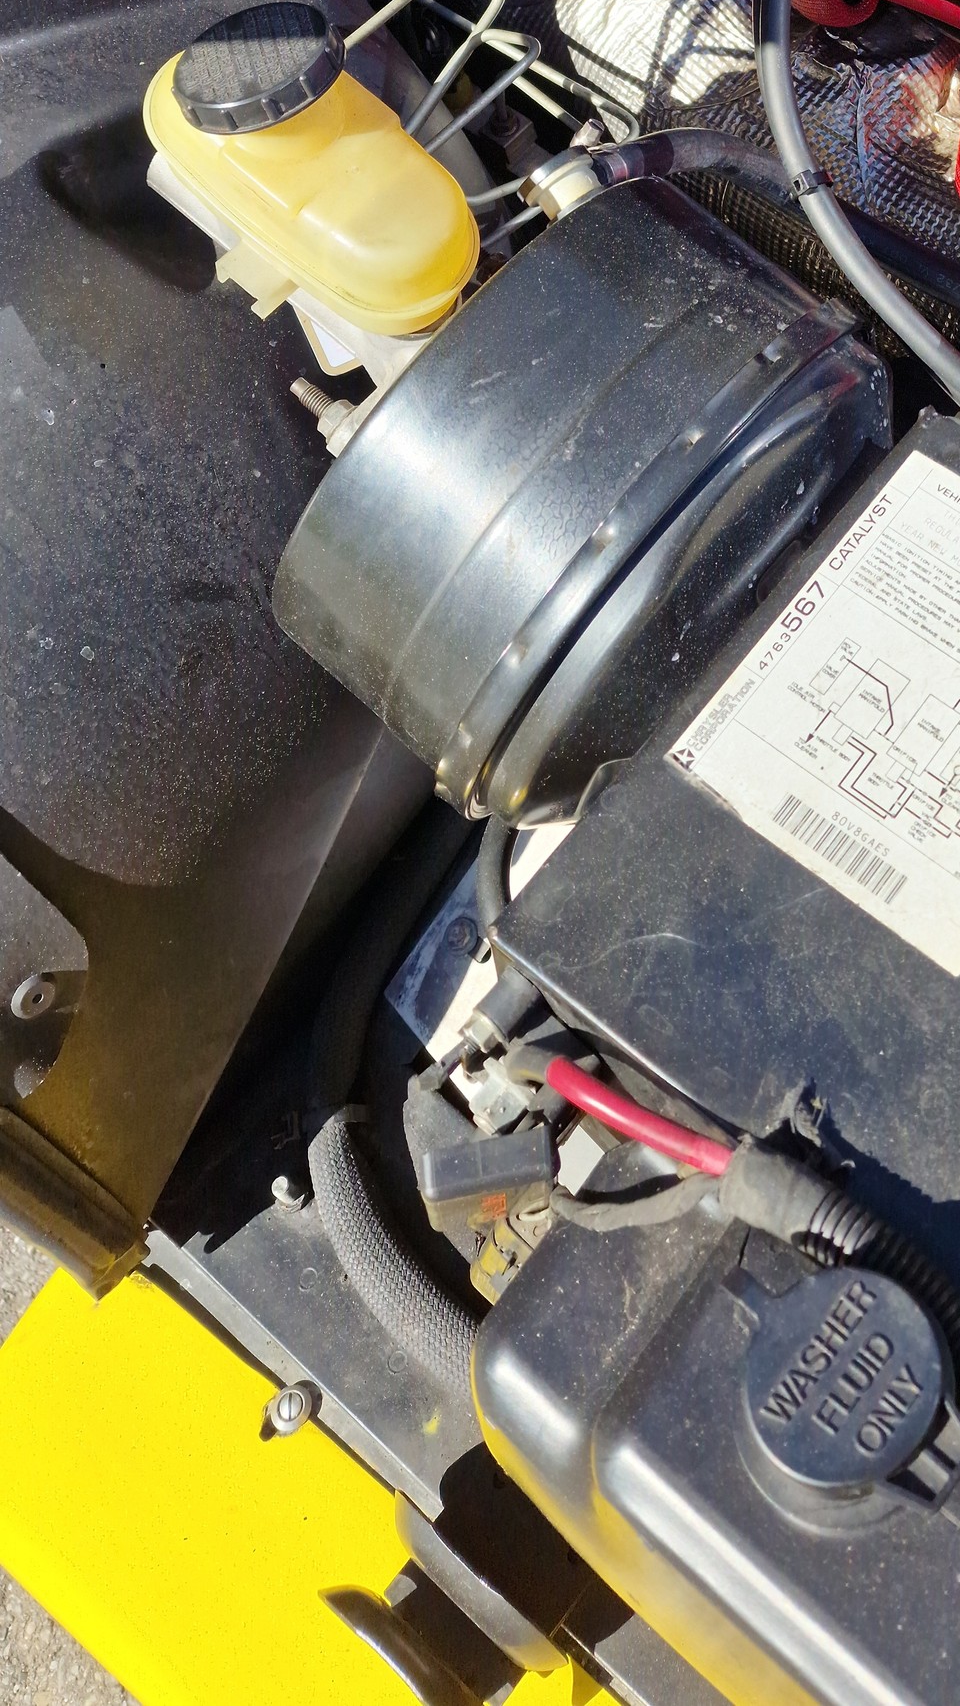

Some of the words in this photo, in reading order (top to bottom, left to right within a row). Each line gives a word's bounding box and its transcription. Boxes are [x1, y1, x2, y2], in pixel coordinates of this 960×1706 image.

[828, 494, 893, 571] CATALYST
[898, 521, 925, 541] YEAR
[926, 539, 948, 556] NEW
[874, 546, 895, 561] MANUAL
[895, 560, 908, 570] FOR
[908, 568, 930, 585] PROPER
[878, 540, 893, 551] HAVE
[894, 550, 910, 562] BEEN
[910, 560, 931, 576] PRESET
[942, 581, 954, 591] THE
[903, 546, 931, 566] IGNITION
[931, 565, 953, 580] TIMING
[854, 571, 878, 589] FEDERAL
[879, 587, 892, 597] AND
[892, 596, 910, 610] STATE
[859, 564, 883, 582] SERVICE
[884, 581, 906, 597] MANUAL
[906, 596, 942, 621] PROCEDURES
[942, 619, 954, 629] MAY
[864, 558, 901, 585] ADJUSTMENTS
[902, 583, 917, 595] MADE
[928, 600, 946, 614] OTHER
[893, 606, 919, 625] PARKING
[919, 623, 938, 638] BRAKE
[938, 636, 955, 649] WHEN
[694, 678, 757, 753] CORPORATION
[857, 692, 885, 713] MANIFOLD
[862, 689, 882, 704] INTAKE
[686, 693, 733, 748] CHRYSLER
[916, 721, 944, 742] MANIFOLD
[920, 718, 940, 733] INTAKE
[793, 741, 818, 760] CLEANER
[814, 735, 838, 753] THROTTLE
[892, 745, 917, 764] ORIFICE
[871, 772, 894, 790] THROTTLE
[911, 793, 935, 812] ORIFICE
[759, 1280, 877, 1424] WASHER
[812, 1332, 895, 1435] FLUID
[855, 1363, 923, 1457] ONLY
